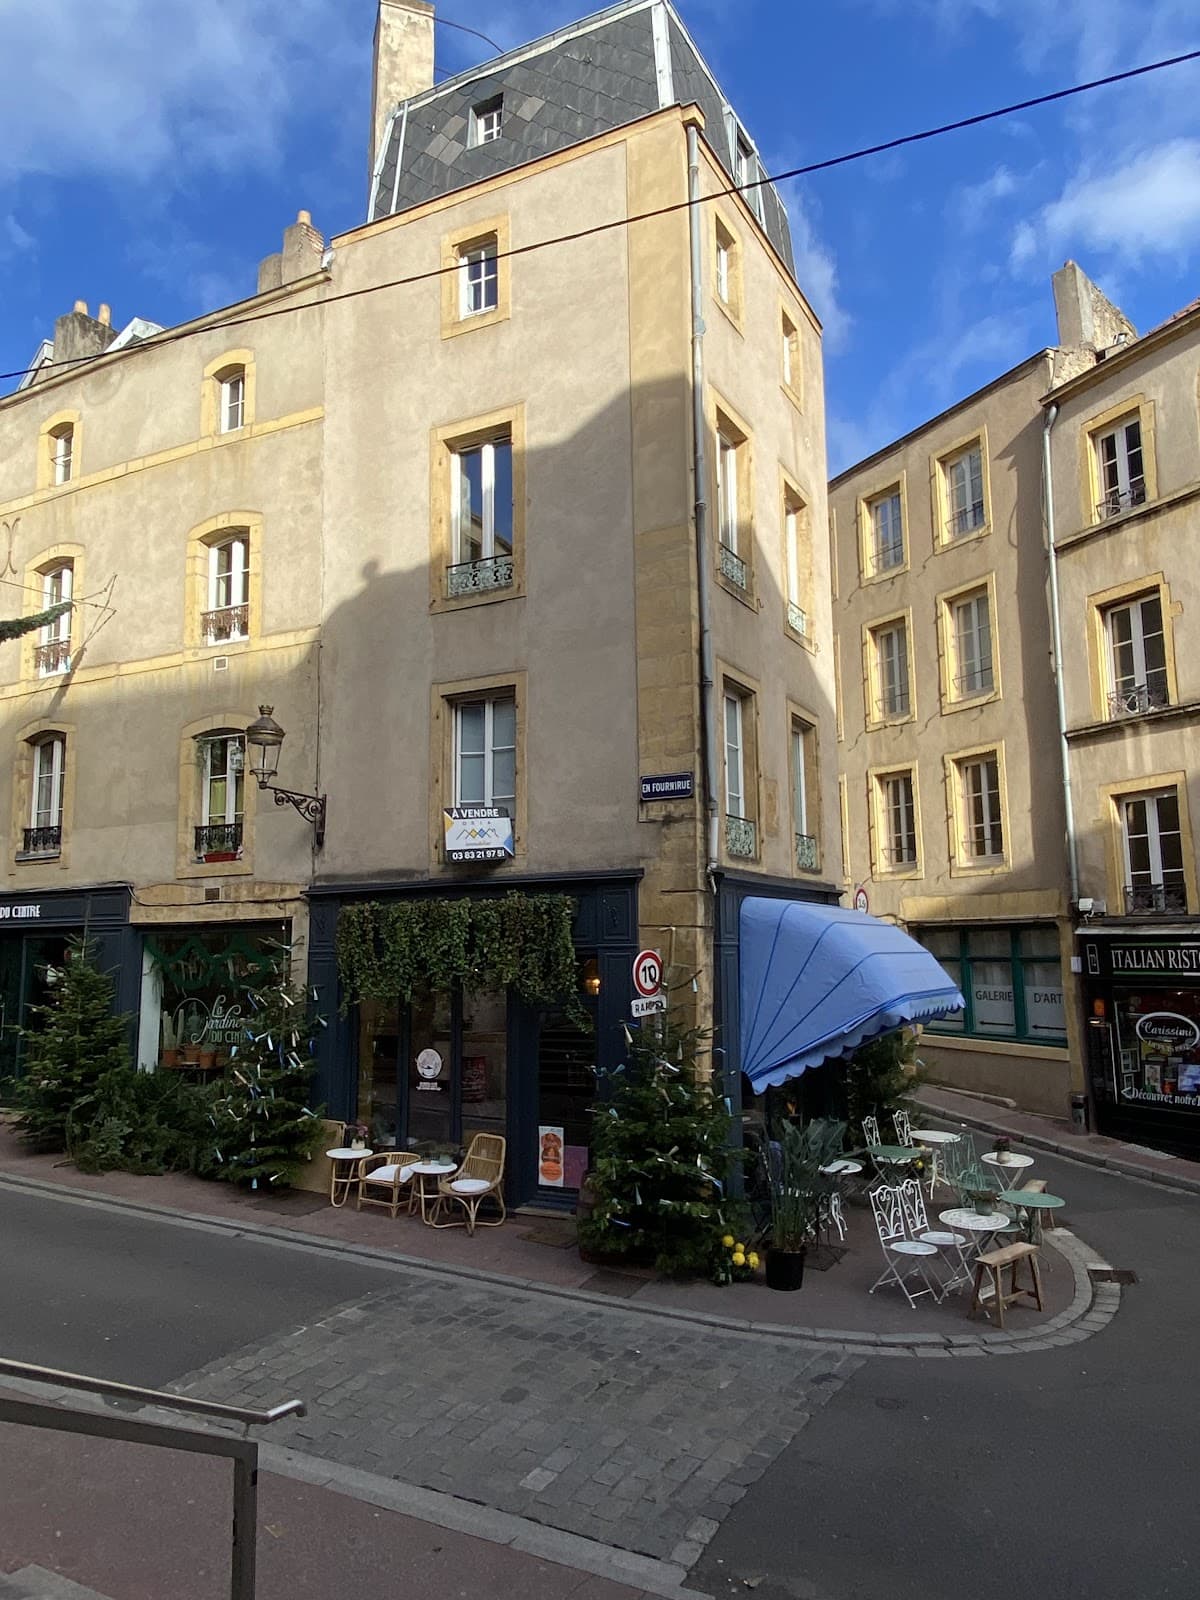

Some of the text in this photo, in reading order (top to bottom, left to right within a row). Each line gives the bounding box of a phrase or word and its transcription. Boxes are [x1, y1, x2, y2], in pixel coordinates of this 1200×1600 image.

[642, 780, 691, 793] EN FOURNIRUE
[460, 808, 499, 818] VENDRE
[452, 852, 463, 860] 03
[476, 850, 485, 859] 21
[486, 849, 496, 858] 97
[12, 904, 41, 918] CENTRE
[1111, 949, 1165, 969] ITALIAN
[1167, 949, 1200, 969] RIST
[642, 964, 657, 984] 10
[975, 990, 1063, 1005] GALERIE D'ART
[212, 995, 226, 1018] La
[212, 1030, 223, 1043] DU
[1141, 1021, 1194, 1038] Carissimi
[1131, 1087, 1174, 1105] Découvrez
[1174, 1094, 1196, 1106] notre
